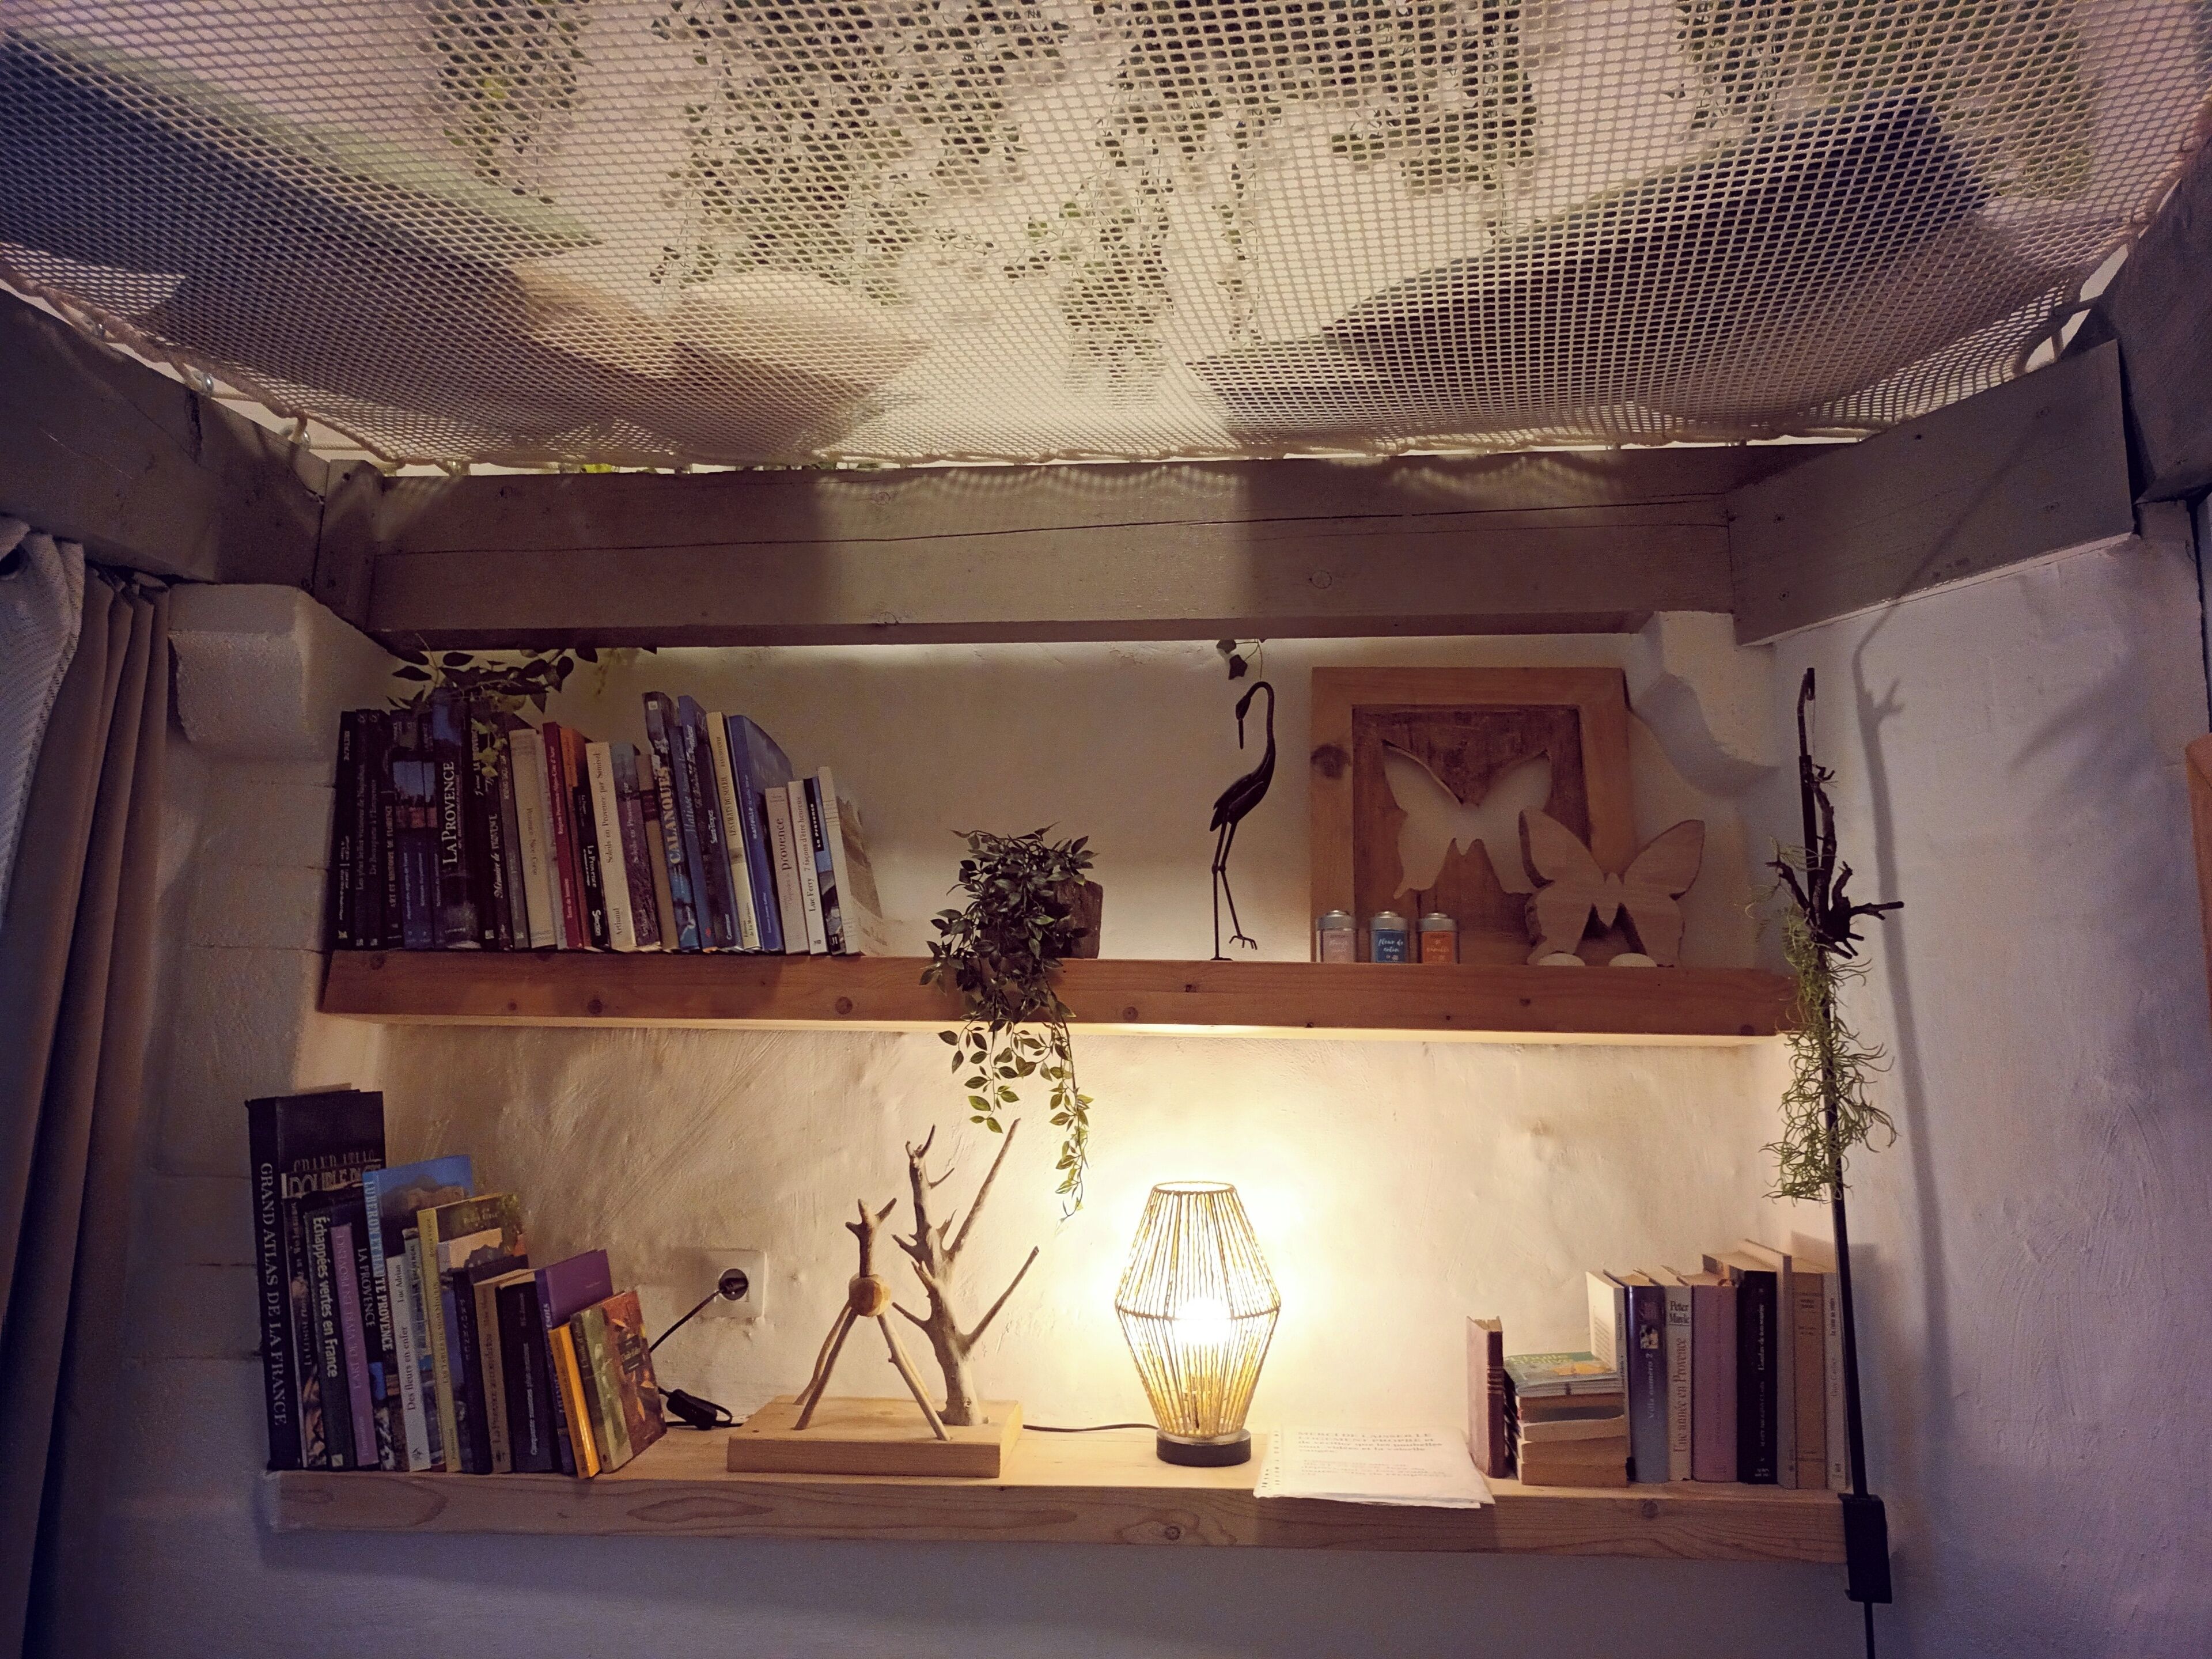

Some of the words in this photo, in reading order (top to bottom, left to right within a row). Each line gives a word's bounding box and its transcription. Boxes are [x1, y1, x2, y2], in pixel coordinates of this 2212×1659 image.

[599, 782, 607, 793] par
[442, 762, 458, 842] PROVENCE
[600, 796, 611, 827] Provence
[796, 796, 805, 823] heureux
[657, 767, 681, 864] CALANQUES
[604, 829, 611, 838] en
[775, 819, 792, 871] provence
[799, 824, 808, 843] d'être
[442, 843, 458, 865] LA
[604, 840, 613, 863] Soleils
[801, 844, 810, 866] façons
[806, 878, 815, 896] Ferry
[808, 898, 816, 912] Luc
[612, 907, 622, 935] Arthaud
[261, 1162, 275, 1225] GRAND
[364, 1180, 380, 1235] LUBERON
[264, 1228, 279, 1285] ATLAS
[312, 1216, 331, 1278] Échappées
[358, 1248, 369, 1262] LA
[370, 1237, 382, 1251] ET
[335, 1232, 350, 1287] PROVENCE
[395, 1264, 403, 1288] Adrian
[267, 1291, 281, 1316] DE
[319, 1280, 333, 1317] vertes
[360, 1265, 376, 1328] PROVENCE
[1669, 1300, 1688, 1311] Peter
[268, 1322, 282, 1347] LA
[323, 1320, 334, 1335] en
[377, 1295, 393, 1351] PROVENCE
[399, 1326, 408, 1350] enfer
[324, 1338, 339, 1378] France
[403, 1352, 411, 1362] en
[1672, 1338, 1687, 1383] Provence
[271, 1351, 286, 1426] FRANCE
[404, 1365, 414, 1391] fleurs
[407, 1393, 416, 1411] Des
[1676, 1387, 1687, 1398] en
[1673, 1401, 1687, 1431] année
[1672, 1433, 1687, 1452] Une
